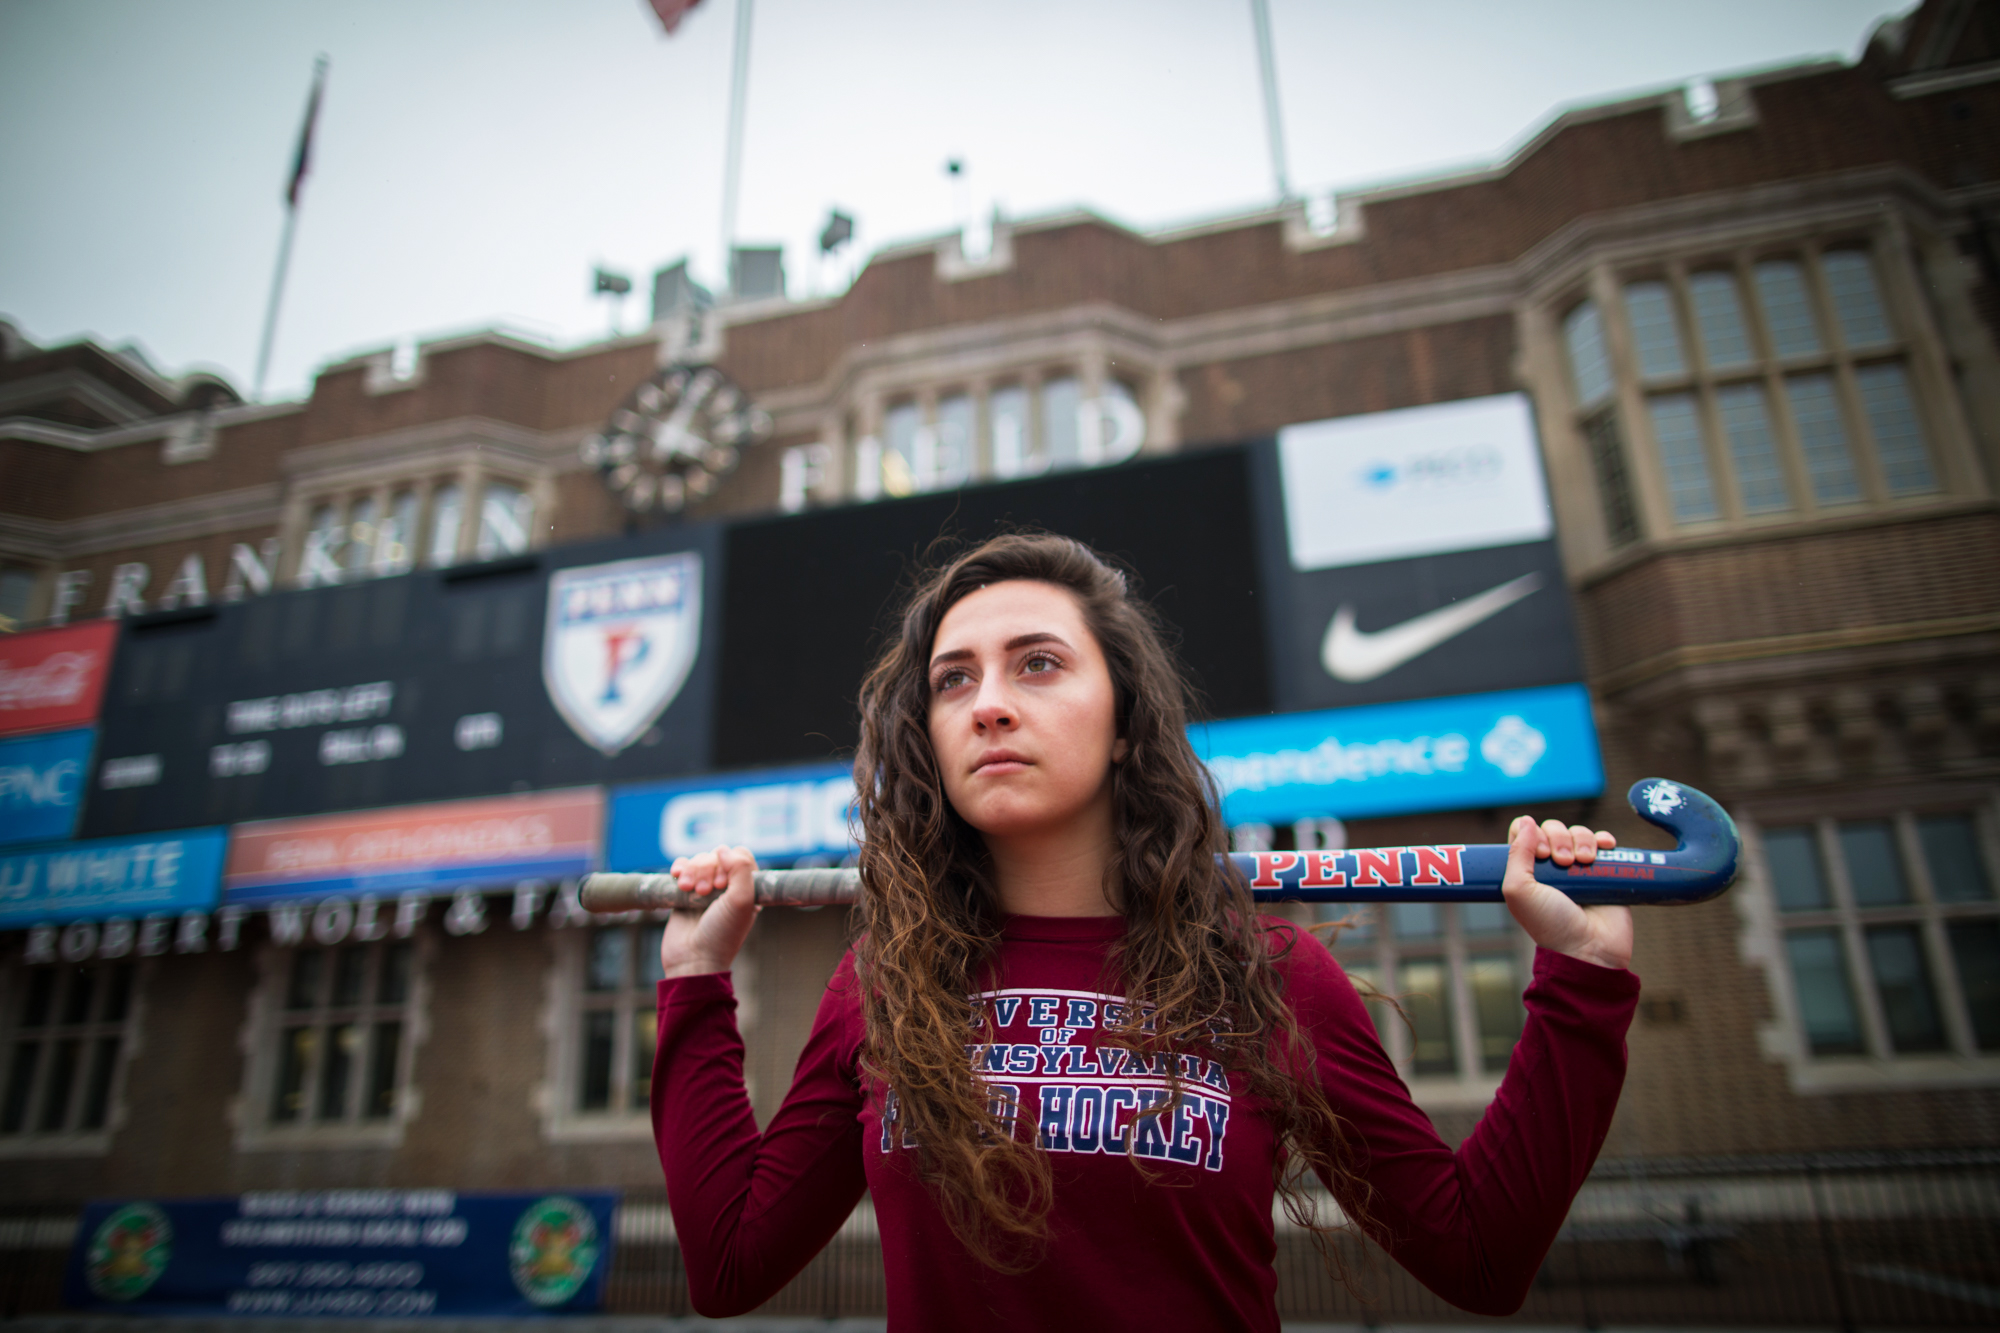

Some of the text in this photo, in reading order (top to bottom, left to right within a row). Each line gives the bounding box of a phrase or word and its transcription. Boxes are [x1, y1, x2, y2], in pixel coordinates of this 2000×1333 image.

[50, 382, 1147, 627] FRANKLIN FIELD
[1201, 733, 1470, 792] pendence
[659, 775, 874, 862] GEIC
[1250, 844, 1466, 890] PENN
[1568, 864, 1655, 880] SAMURAI
[24, 904, 249, 964] ROBERT
[268, 887, 432, 947] WOLF
[1039, 1027, 1077, 1045] OF
[1036, 1084, 1230, 1172] HOCKEY
